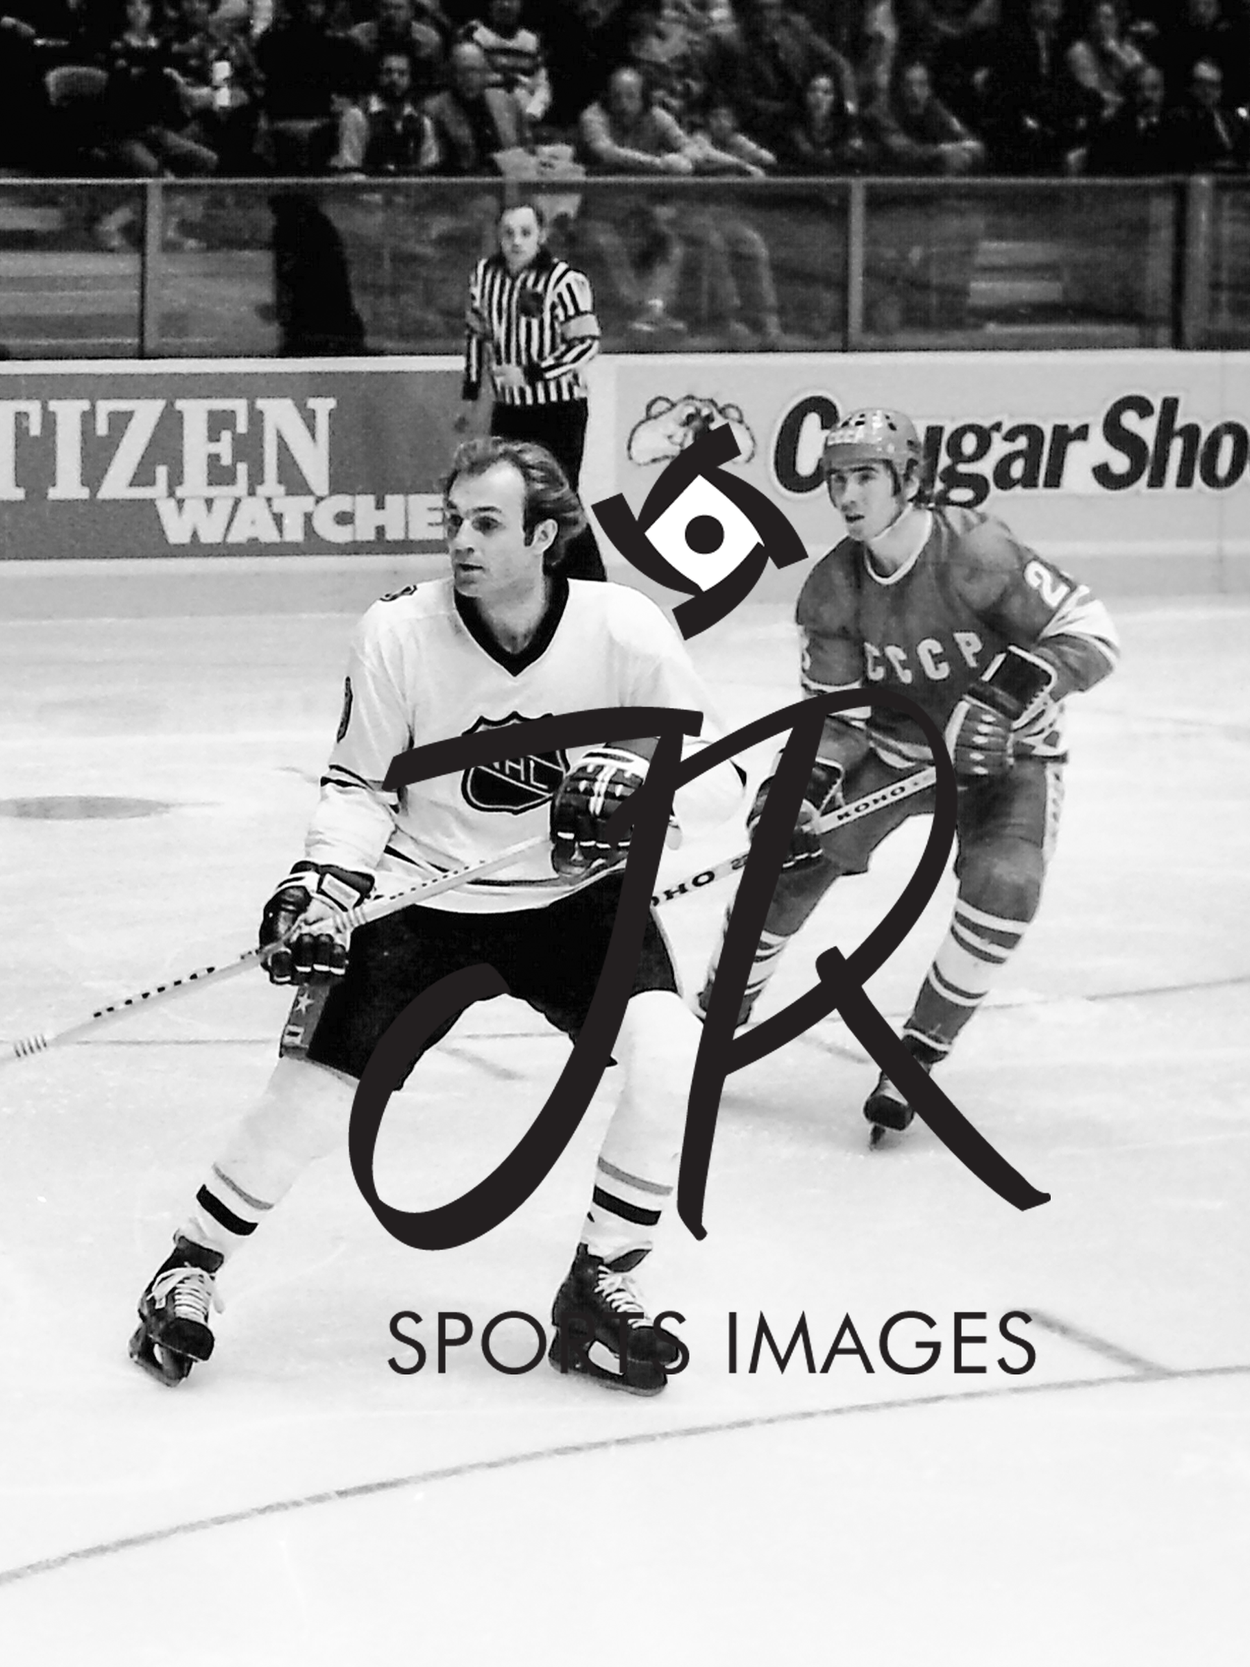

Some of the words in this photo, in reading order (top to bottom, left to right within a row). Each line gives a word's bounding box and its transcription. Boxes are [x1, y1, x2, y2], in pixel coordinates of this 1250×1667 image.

[774, 395, 1090, 509] Cgar
[154, 493, 447, 544] WATCHE
[836, 785, 906, 821] KOHO
